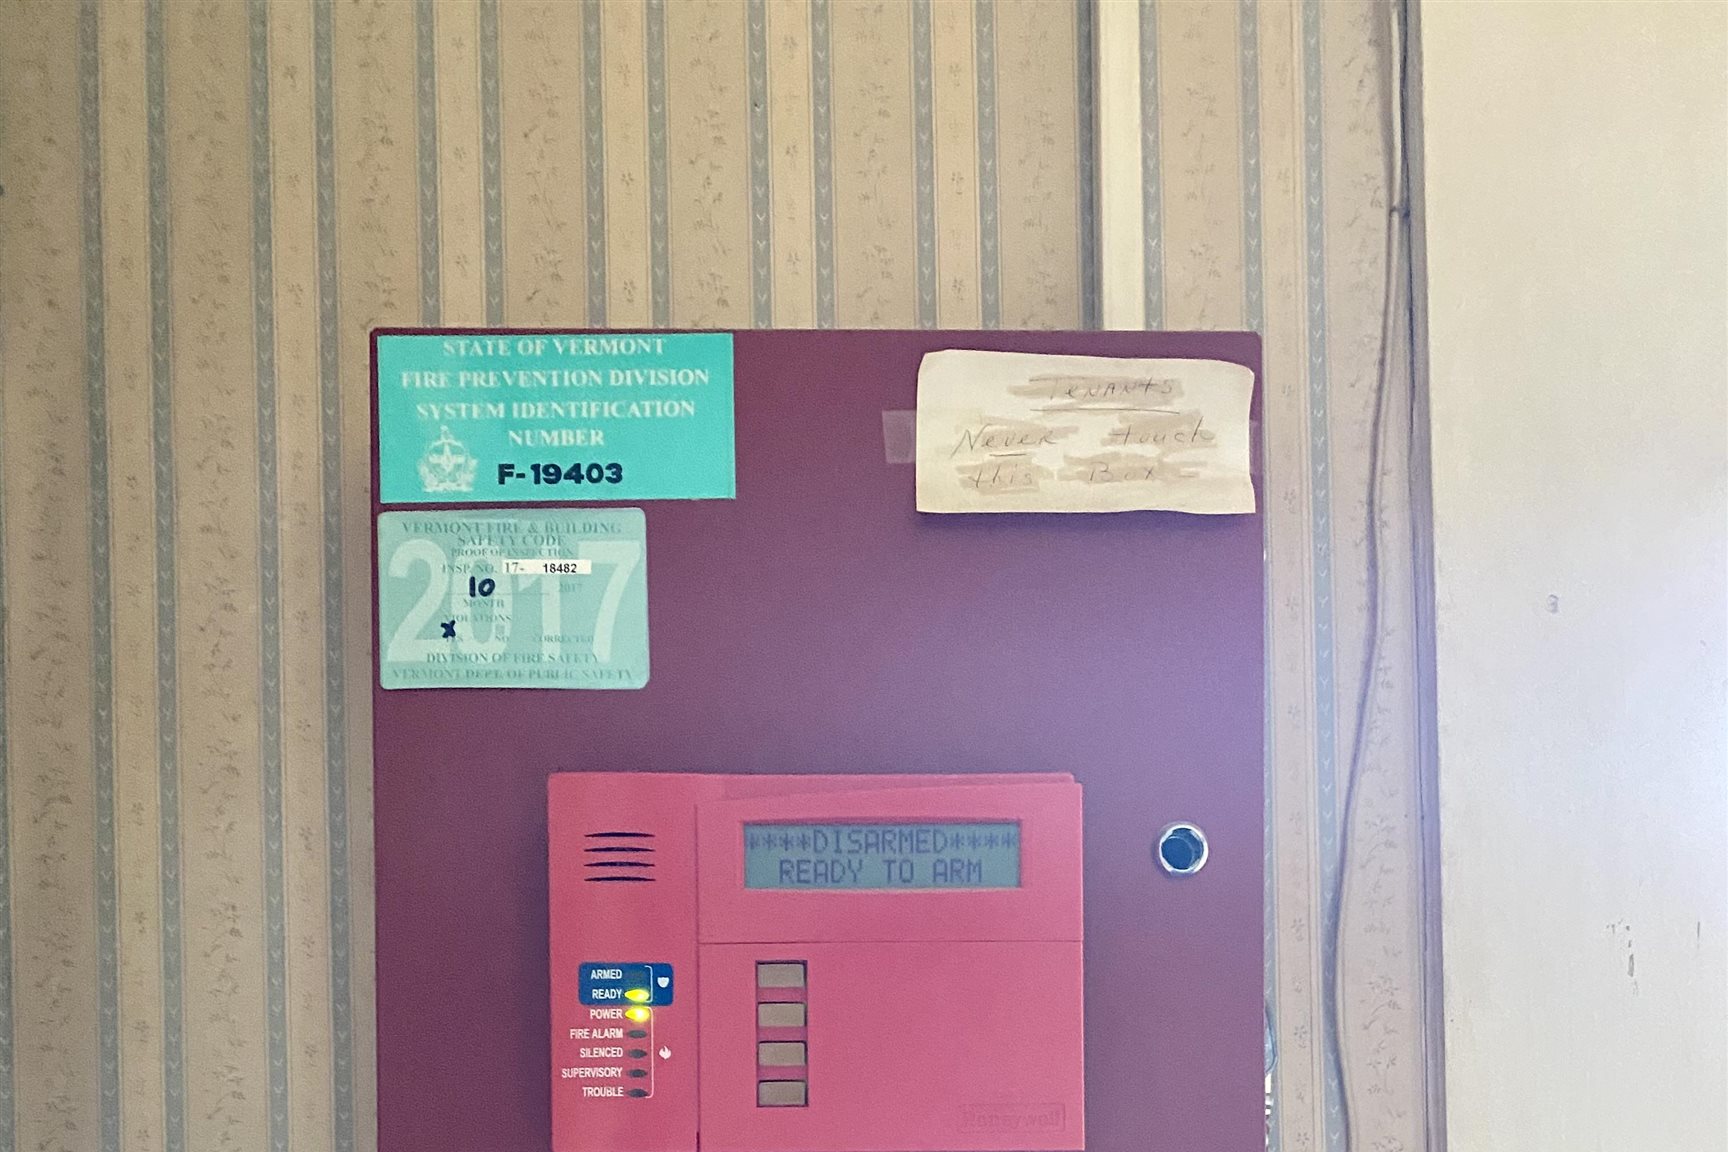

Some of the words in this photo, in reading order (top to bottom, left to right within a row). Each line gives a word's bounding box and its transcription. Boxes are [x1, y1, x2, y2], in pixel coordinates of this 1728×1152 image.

[443, 339, 511, 356] STATE
[516, 339, 548, 356] OF
[552, 338, 667, 355] VERMONT
[401, 371, 449, 388] FIRE
[459, 369, 603, 388] PREVENTION
[609, 368, 710, 386] DIVISION
[416, 402, 505, 420] SYSTEM
[512, 400, 696, 418] IDENTIFICATION
[508, 429, 605, 447] NUMBER
[497, 462, 624, 485] F-19403
[967, 462, 1034, 489] this
[401, 521, 484, 534] VERMONT
[486, 522, 522, 533] FIRE
[527, 522, 539, 533] &
[544, 521, 622, 534] BUILDING
[457, 534, 519, 546] SAFETY
[522, 534, 566, 546] CODE
[542, 563, 578, 573] 18482
[469, 576, 496, 598] 10
[387, 538, 642, 664] 2017
[426, 653, 489, 664] DIVISION
[491, 653, 509, 664] OF
[513, 653, 544, 664] FIRE
[548, 653, 600, 664] SAFETY
[392, 669, 462, 679] VERMONT
[779, 859, 863, 884] READY
[883, 859, 914, 883] TO
[933, 859, 982, 883] ARM
[590, 969, 622, 979] ARMED
[592, 989, 622, 999] READY
[590, 1009, 623, 1019] POWER
[570, 1029, 589, 1039] FIRE
[591, 1028, 623, 1038] ALARM
[580, 1048, 623, 1057] SILENCED
[561, 1067, 623, 1078] SUPERVISORY
[582, 1087, 624, 1097] TROUBLE
